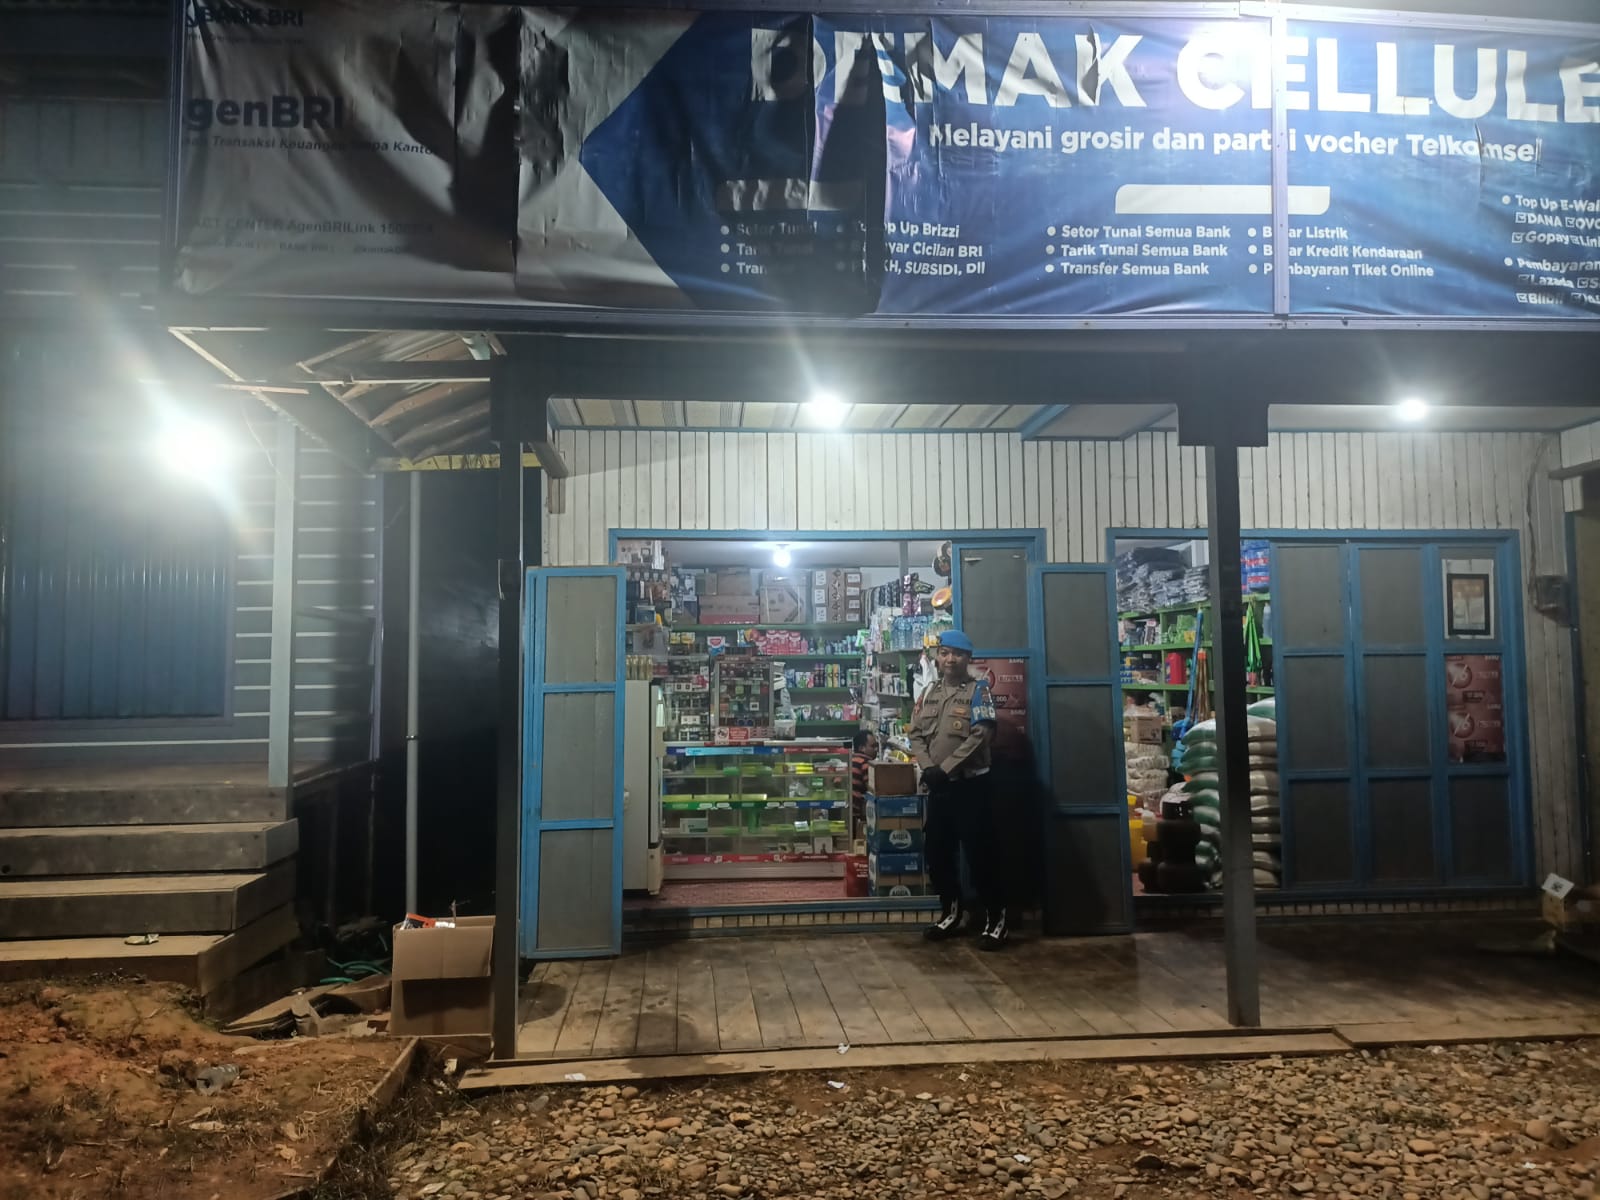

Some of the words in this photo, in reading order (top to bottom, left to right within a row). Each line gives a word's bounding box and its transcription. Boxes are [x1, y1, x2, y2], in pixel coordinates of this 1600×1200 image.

[212, 136, 275, 149] Transaksi
[393, 142, 434, 154] Kanto
[1060, 126, 1144, 153] grosir
[1152, 127, 1204, 150] dan
[1213, 128, 1297, 155] parti
[1304, 132, 1398, 155] vocher
[1515, 195, 1538, 209] Top
[1540, 198, 1558, 212] Up
[1527, 213, 1563, 227] DANA
[900, 221, 919, 236] Up
[922, 223, 960, 238] Brizzi
[1061, 225, 1099, 238] Setor
[1103, 225, 1142, 238] Tunai
[1145, 226, 1192, 238] Semua
[1196, 226, 1231, 238] Bank
[1262, 226, 1303, 238] Bar
[1306, 226, 1349, 239] Listrik
[1525, 231, 1569, 245] Gopay
[912, 242, 955, 257] Cicilan
[958, 245, 983, 258] BRI
[1061, 244, 1096, 257] Tarik
[1100, 244, 1138, 257] Tunai
[1142, 244, 1189, 256] Semua
[1193, 244, 1229, 256] Bank
[1263, 245, 1303, 257] Bar
[1306, 245, 1349, 258] Kredit
[1352, 245, 1423, 260] Kendaraan
[904, 261, 962, 276] SUBSIDI,
[1061, 262, 1119, 275] Transfer
[1122, 263, 1170, 275] Semua
[1174, 263, 1210, 276] Bank
[1263, 263, 1349, 278] Pmbayaran
[1352, 264, 1387, 277] Tiket
[1390, 264, 1435, 277] Online
